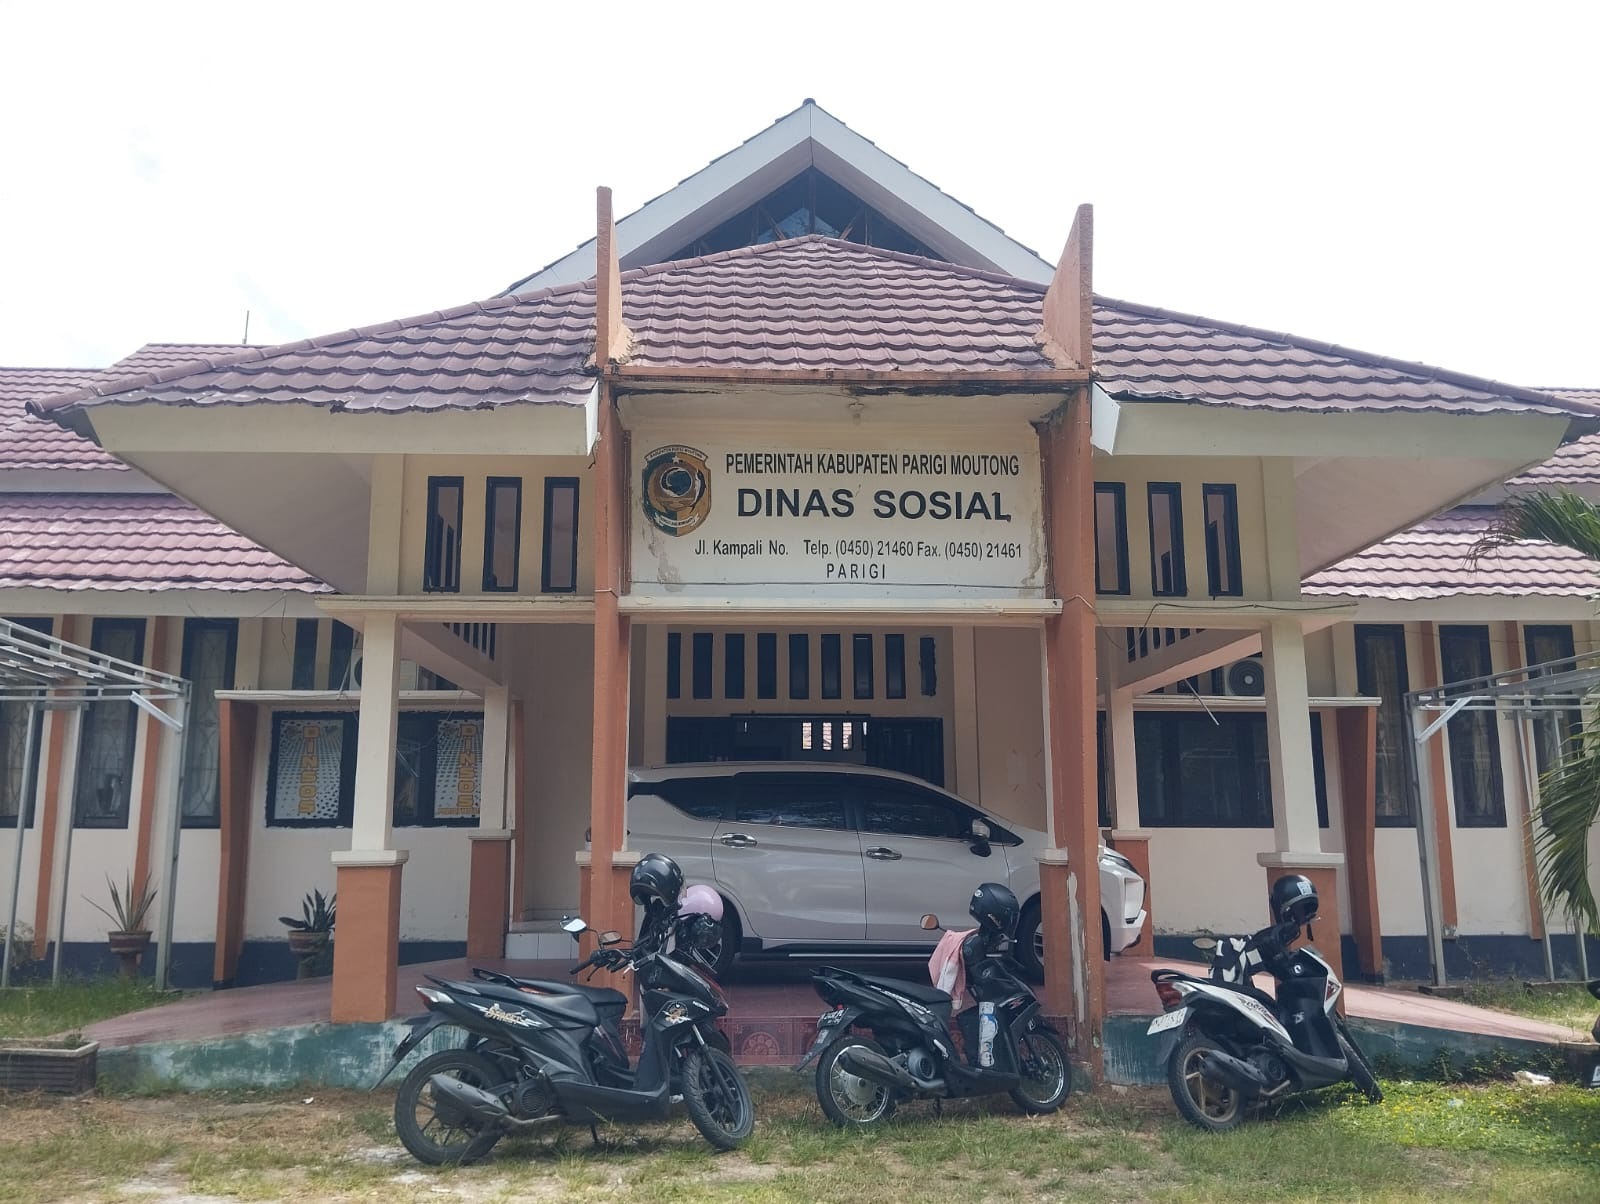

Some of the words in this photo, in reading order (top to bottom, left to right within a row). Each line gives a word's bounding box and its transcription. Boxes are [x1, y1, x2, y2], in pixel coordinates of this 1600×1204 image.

[726, 453, 813, 474] PEMERINTAH
[817, 453, 898, 475] KABUPATEN
[902, 454, 947, 475] PARIGI
[951, 454, 1020, 476] MOUTONG
[737, 488, 855, 518] DINAS
[873, 489, 1012, 522] SOSIAL
[695, 539, 709, 556] Jl.
[713, 539, 763, 559] Kampali
[769, 539, 789, 556] No.
[803, 539, 832, 559] Telp.
[835, 540, 874, 560] (0450)
[877, 541, 914, 557] 21460
[917, 541, 941, 558] Fax.
[944, 541, 983, 561] (0450)
[986, 542, 1022, 559] 21461
[826, 563, 886, 580] PARIGI
